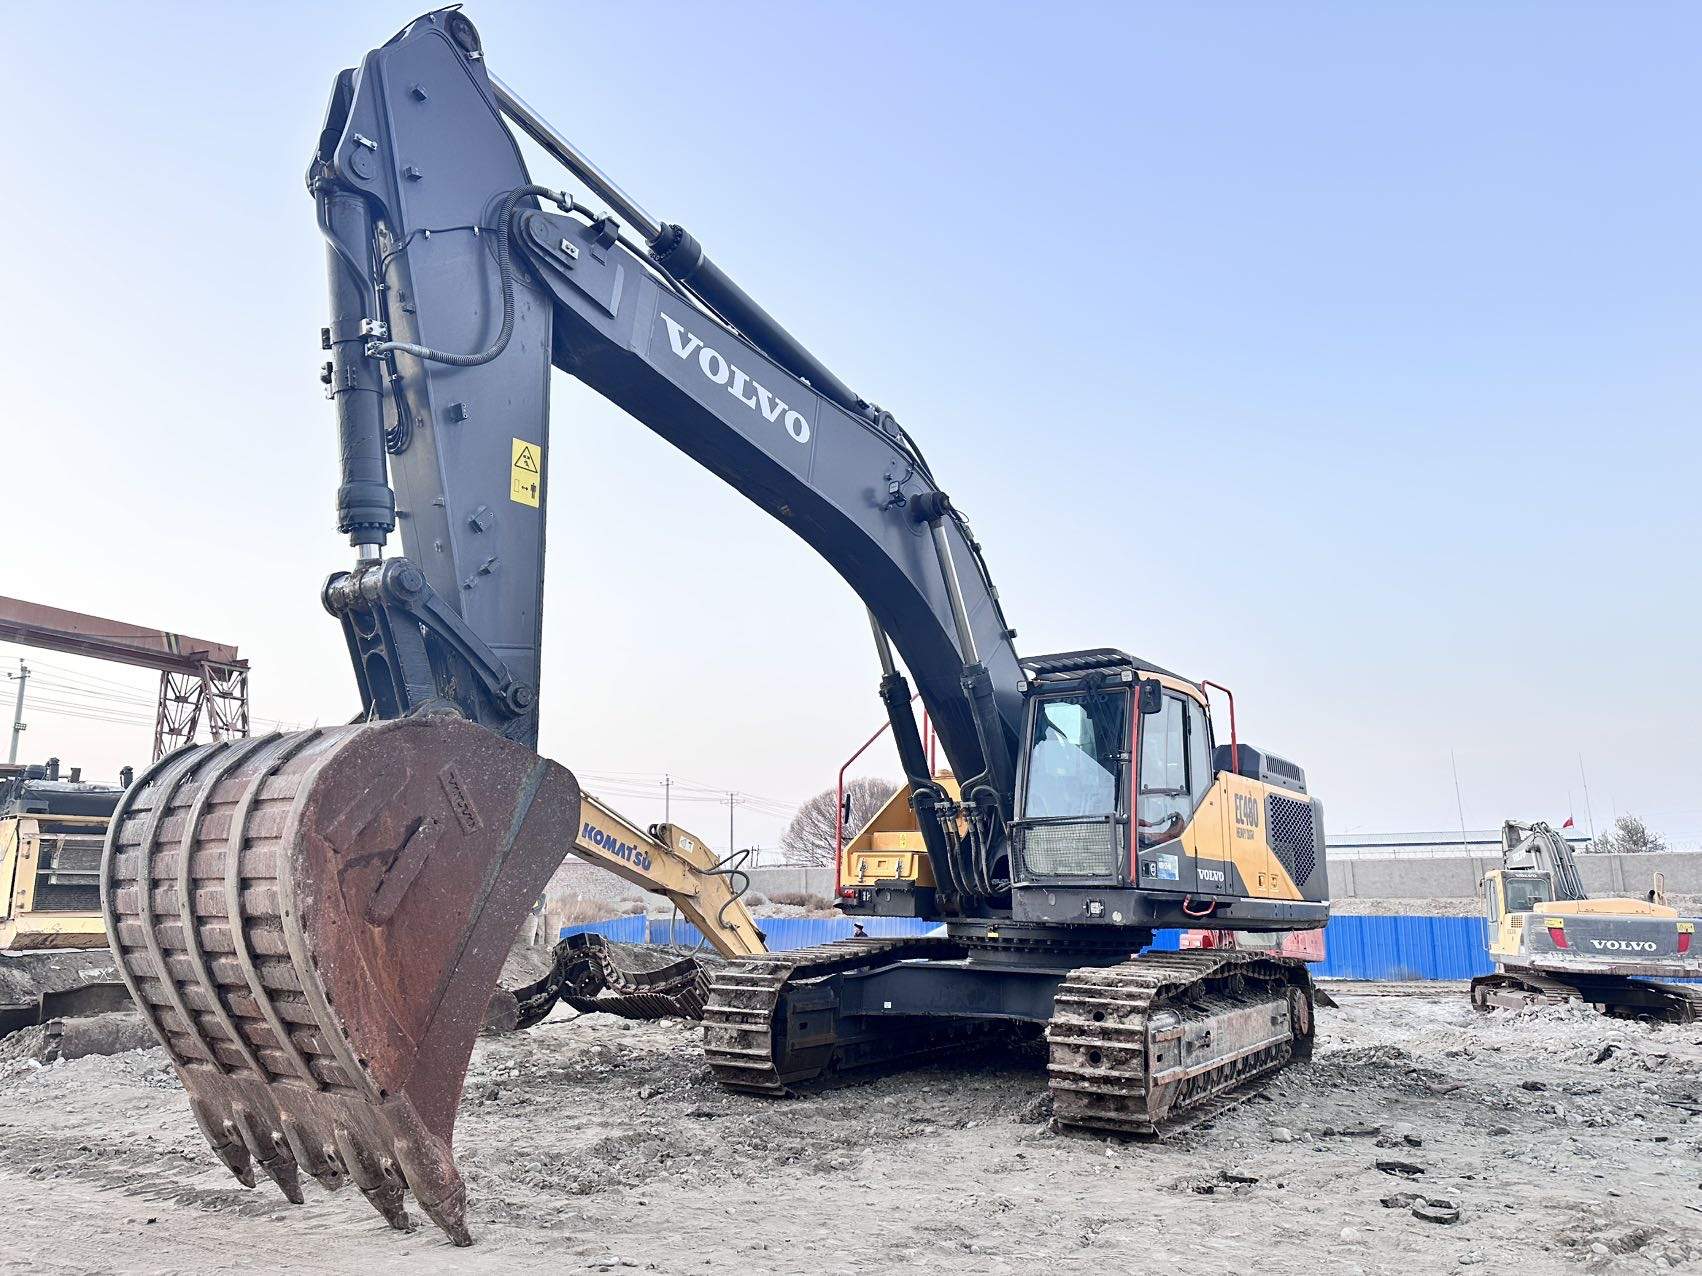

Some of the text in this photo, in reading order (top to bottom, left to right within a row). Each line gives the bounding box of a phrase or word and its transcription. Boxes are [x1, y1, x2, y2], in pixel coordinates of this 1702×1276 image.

[660, 311, 811, 443] VOLVO
[1234, 793, 1259, 828] EC480
[581, 822, 651, 871] KOMATSU
[1197, 869, 1225, 881] VOLVO
[1590, 939, 1657, 952] VOLVO
